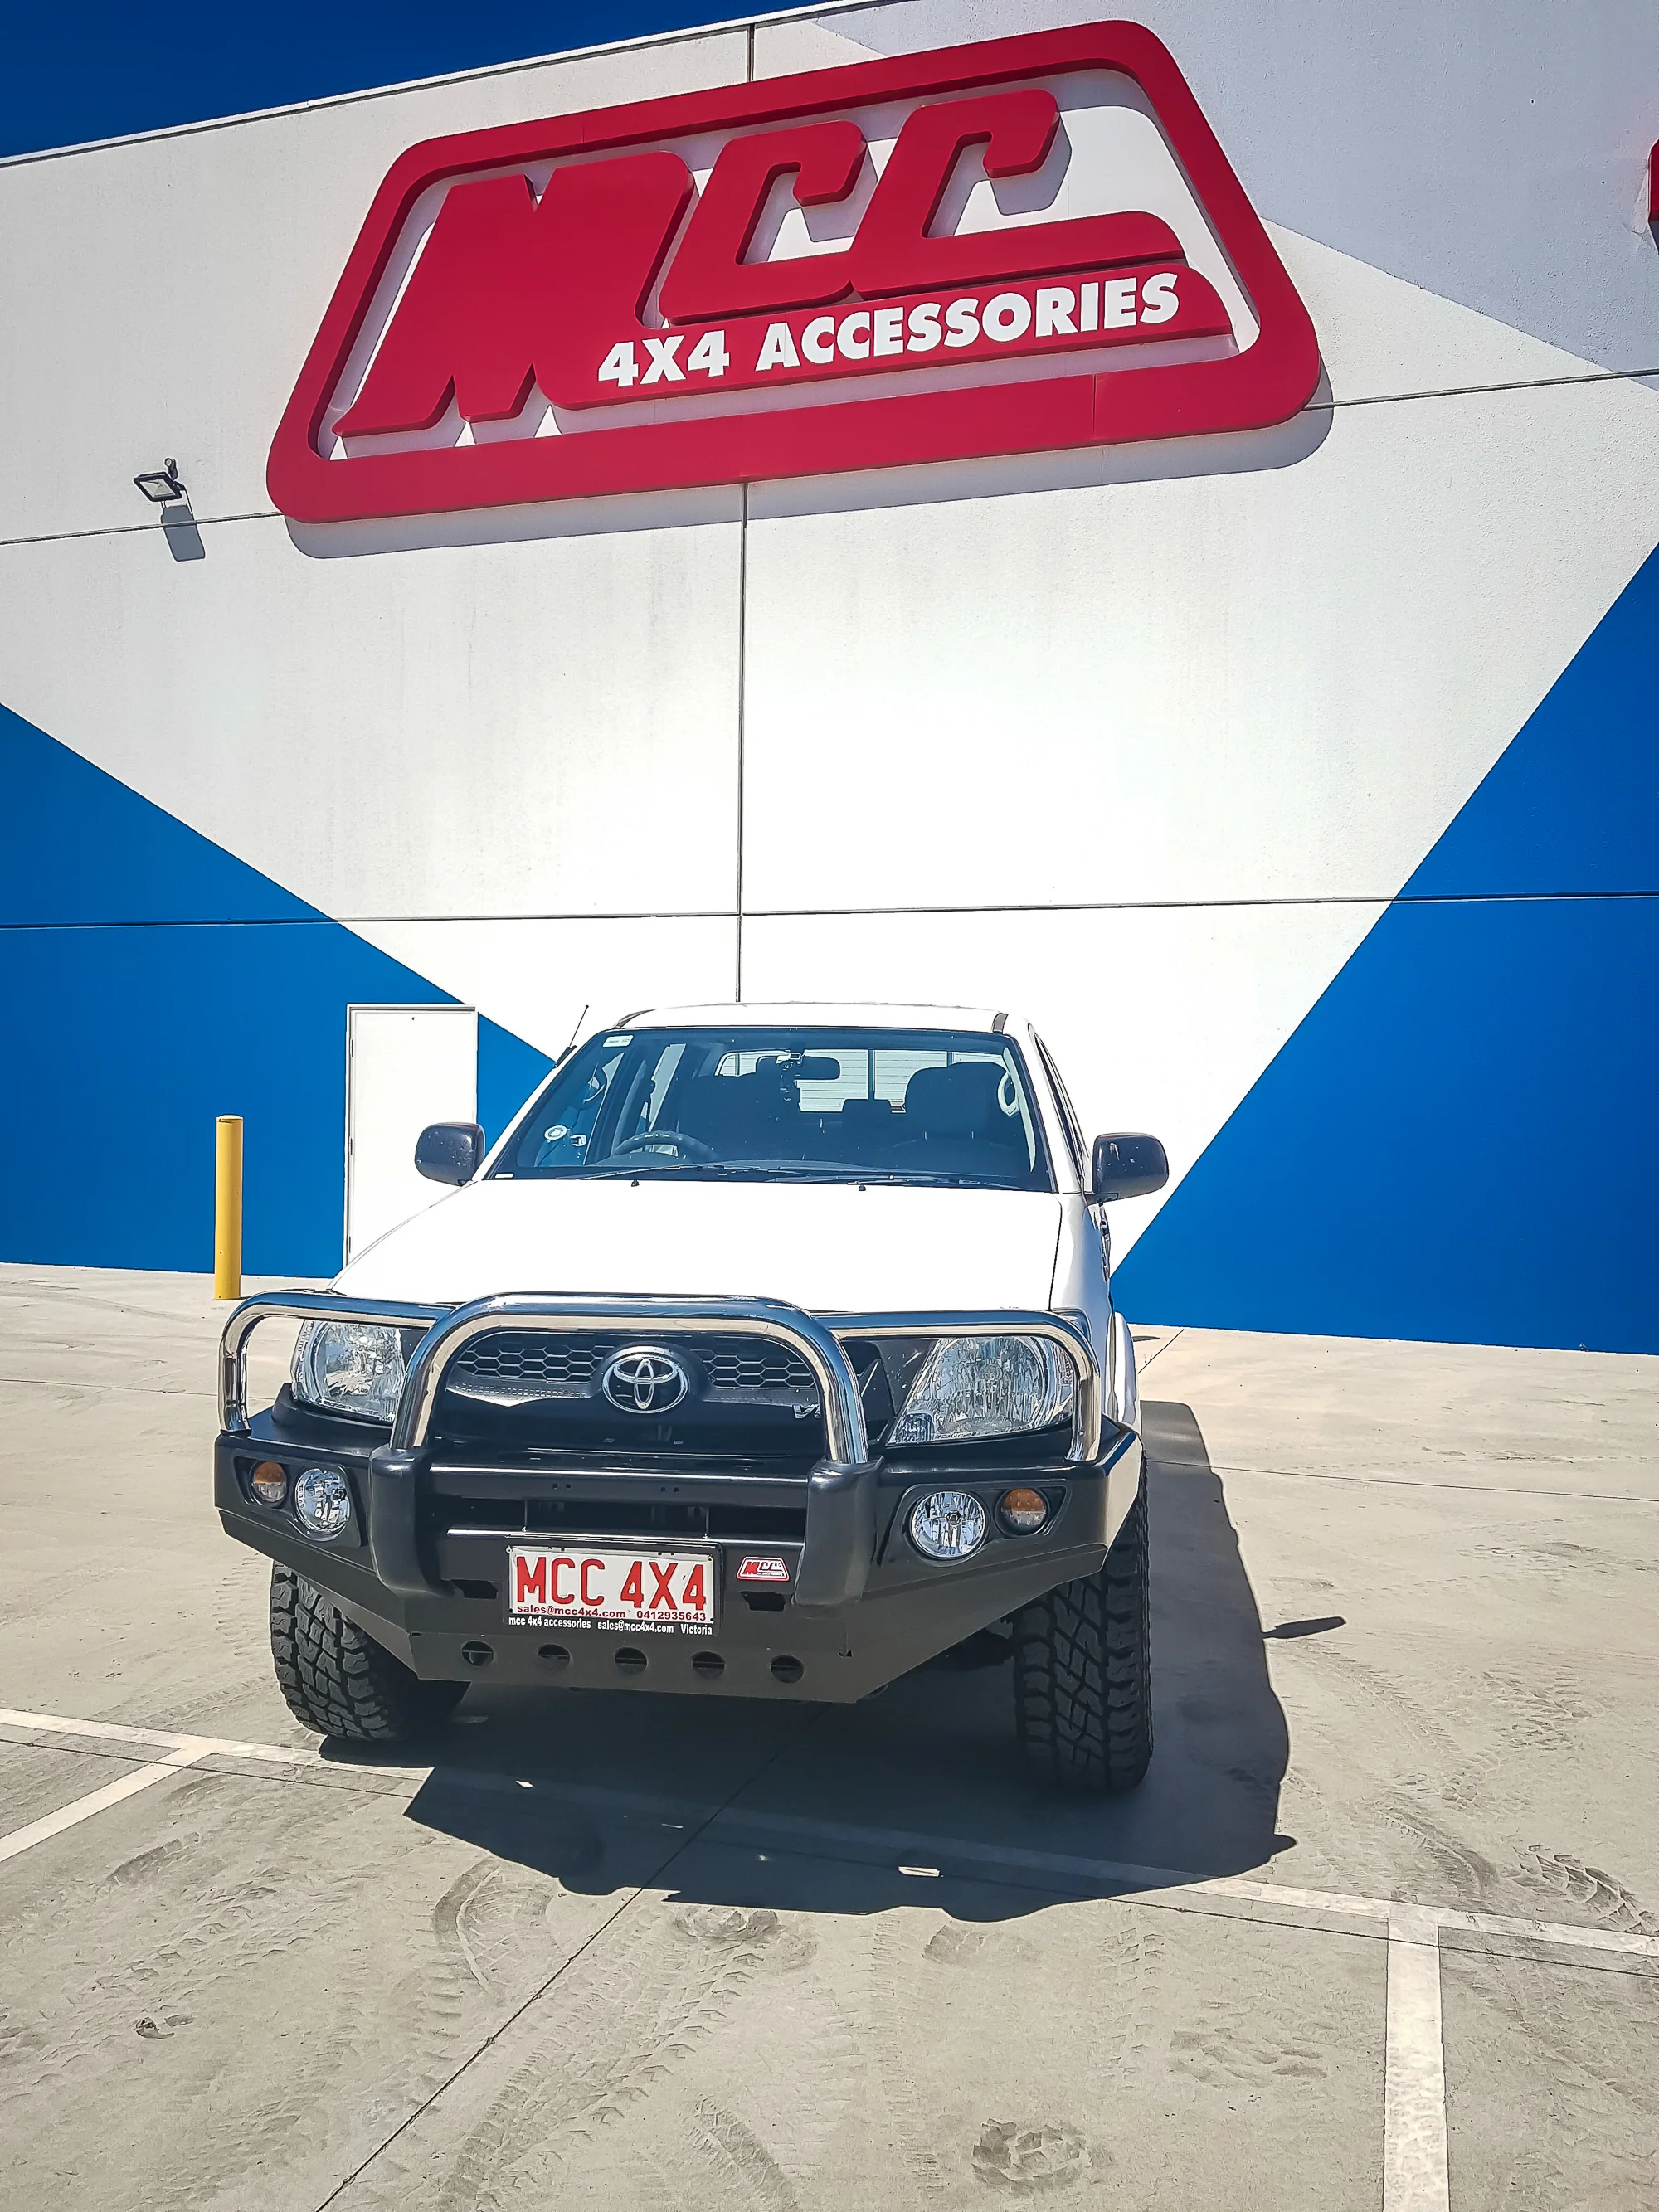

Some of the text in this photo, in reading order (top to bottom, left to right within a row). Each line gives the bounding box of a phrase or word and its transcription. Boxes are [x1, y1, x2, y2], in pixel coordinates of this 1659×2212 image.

[333, 88, 1186, 438] MCC
[597, 274, 1179, 387] 4X4 ACCESSORIES
[516, 1556, 707, 1611] MCC 4X4
[742, 1561, 783, 1574] MCC
[508, 1616, 713, 1635] mcc 4x4 accessories sales@mcc4x4.com Victoria
[517, 1605, 707, 1621] sales@mcc4x4.com 0412935643
